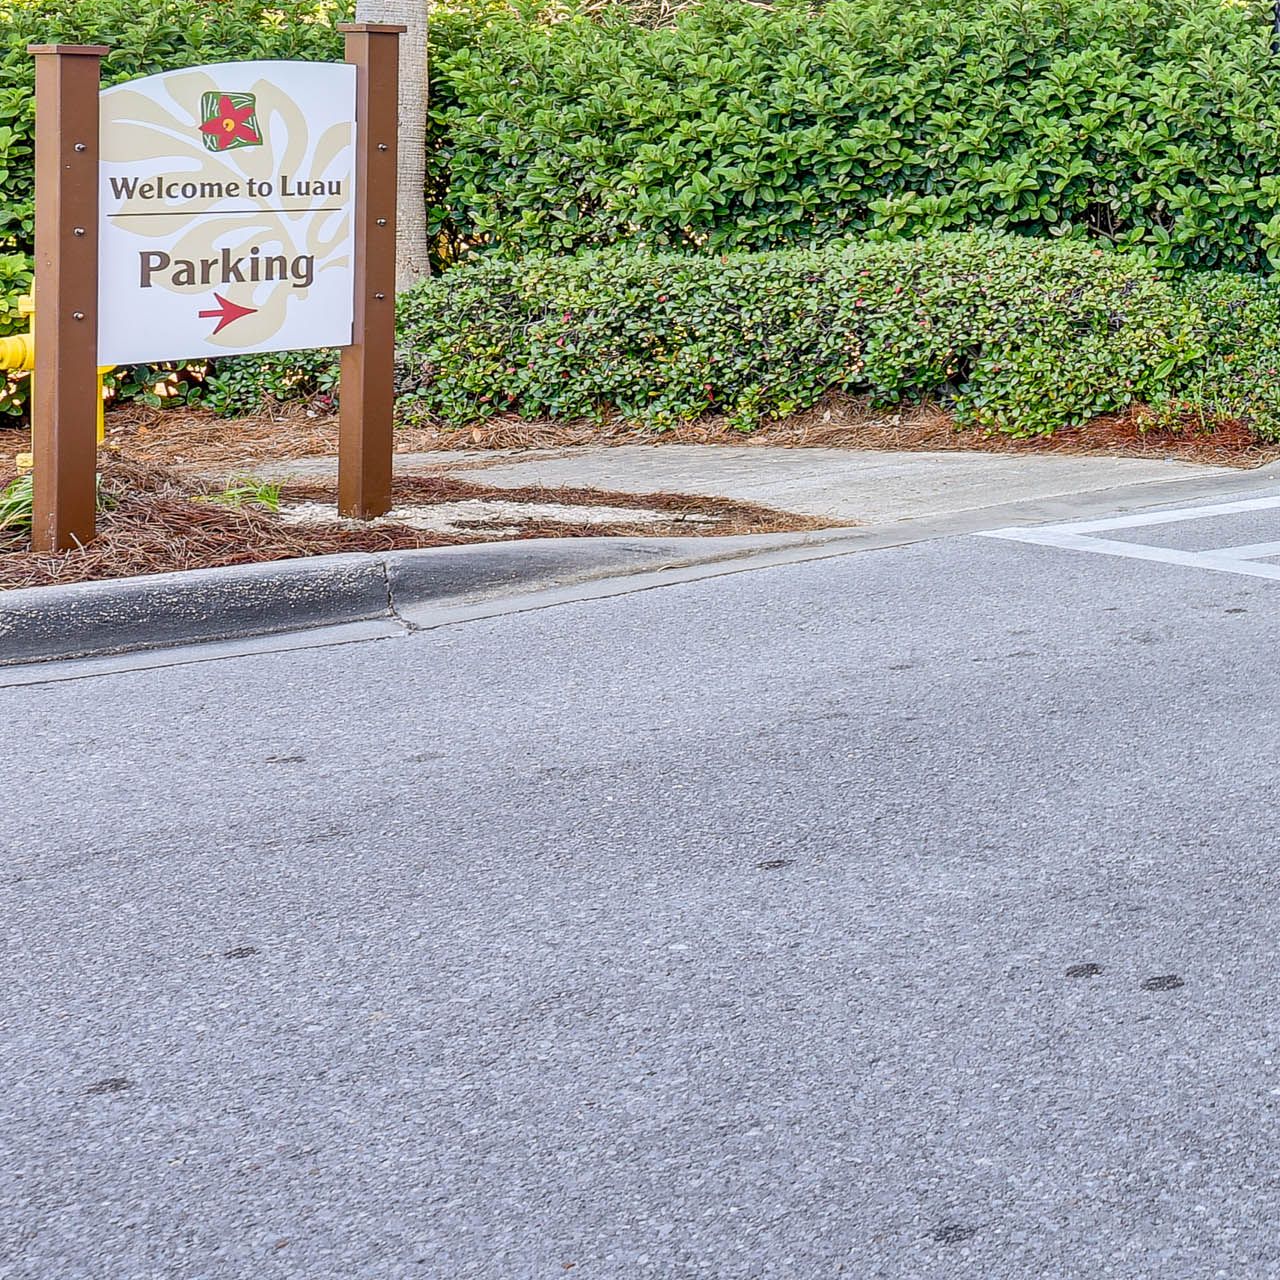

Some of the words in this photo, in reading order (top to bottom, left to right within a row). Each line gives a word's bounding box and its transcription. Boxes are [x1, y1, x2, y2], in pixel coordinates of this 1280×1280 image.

[109, 176, 240, 200] Welcome
[248, 177, 273, 198] to
[281, 175, 342, 197] Luau
[138, 246, 315, 289] Parking
